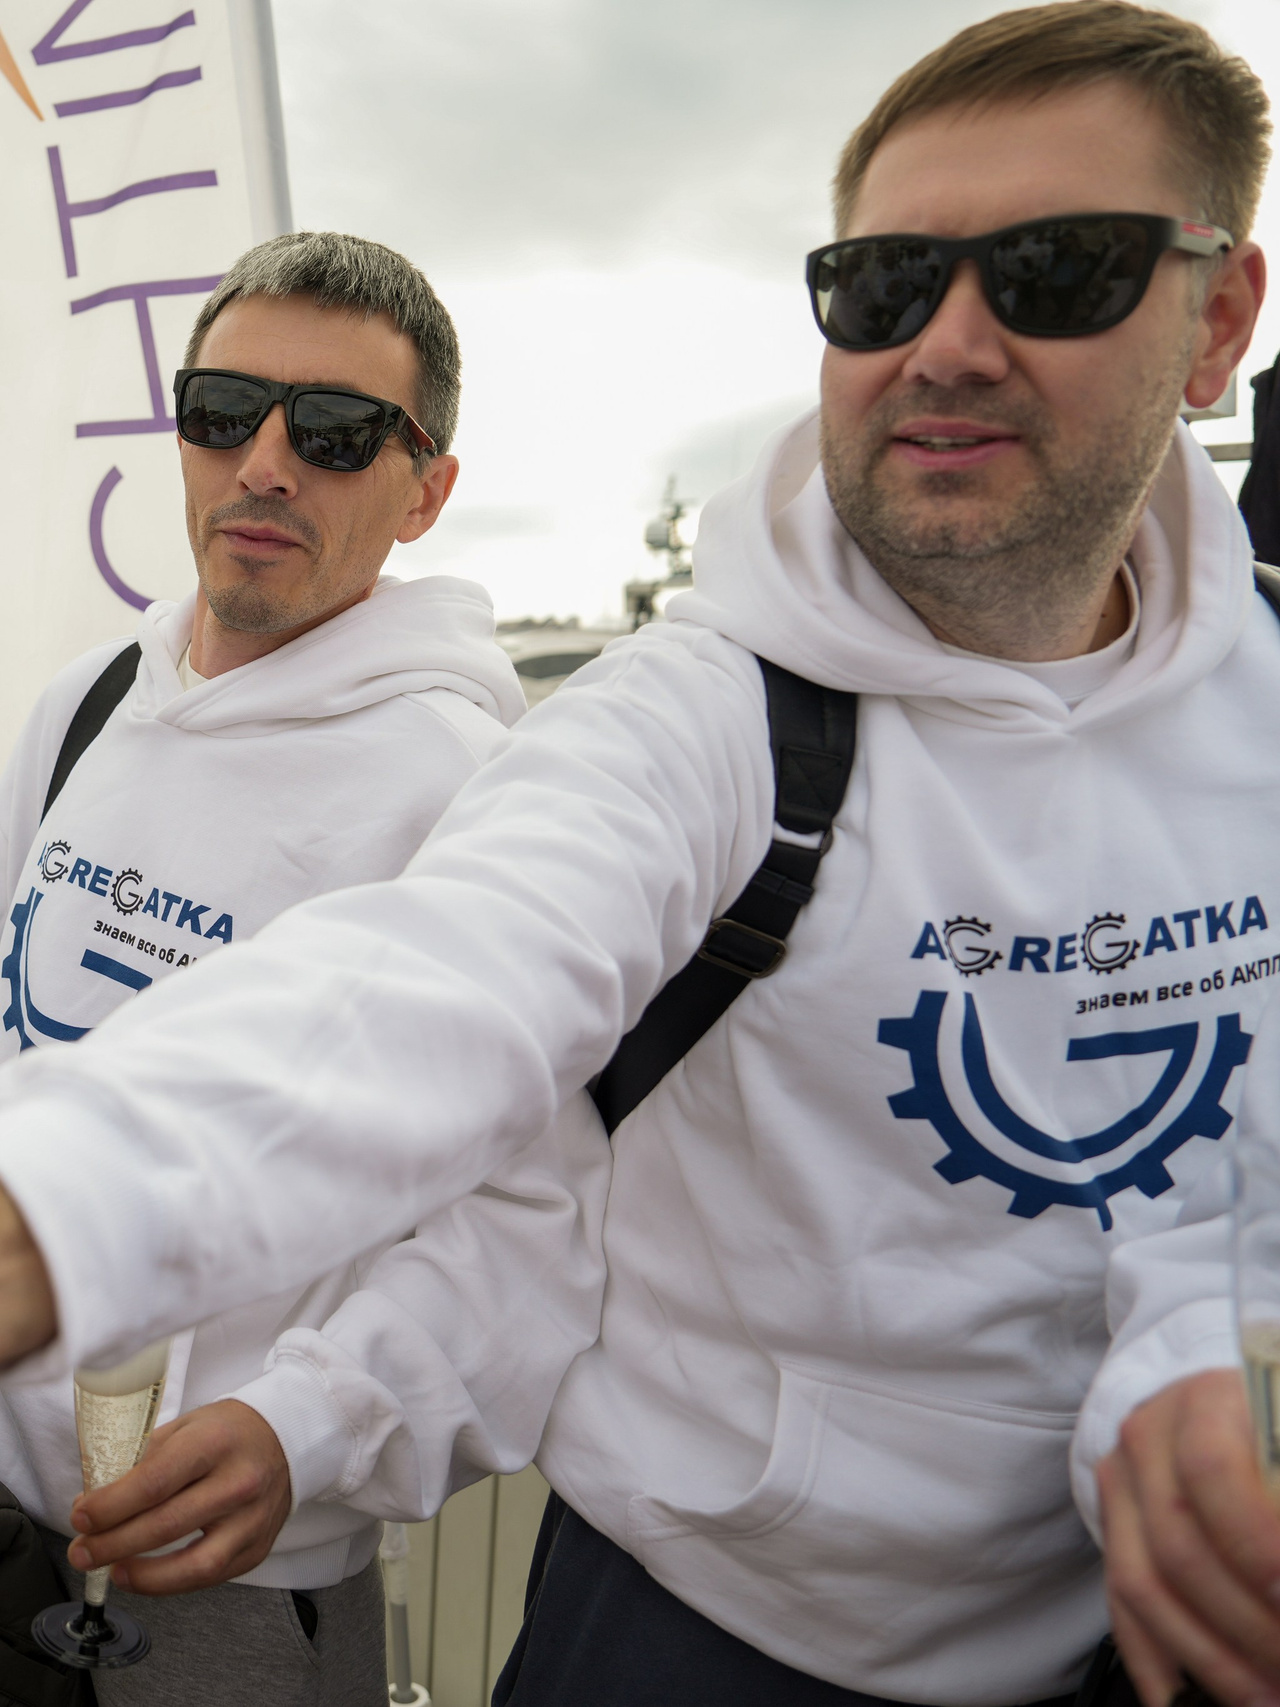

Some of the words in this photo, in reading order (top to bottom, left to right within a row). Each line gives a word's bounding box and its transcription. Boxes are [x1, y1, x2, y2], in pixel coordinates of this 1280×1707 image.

[37, 839, 234, 946] GREGATKA
[93, 919, 136, 947] знаем
[136, 938, 157, 957] все
[158, 948, 176, 965] об
[176, 953, 198, 968] А
[910, 895, 1269, 978] AGREGATKA
[1075, 988, 1150, 1015] знаем
[1156, 981, 1194, 1002] все
[1200, 969, 1225, 993] об
